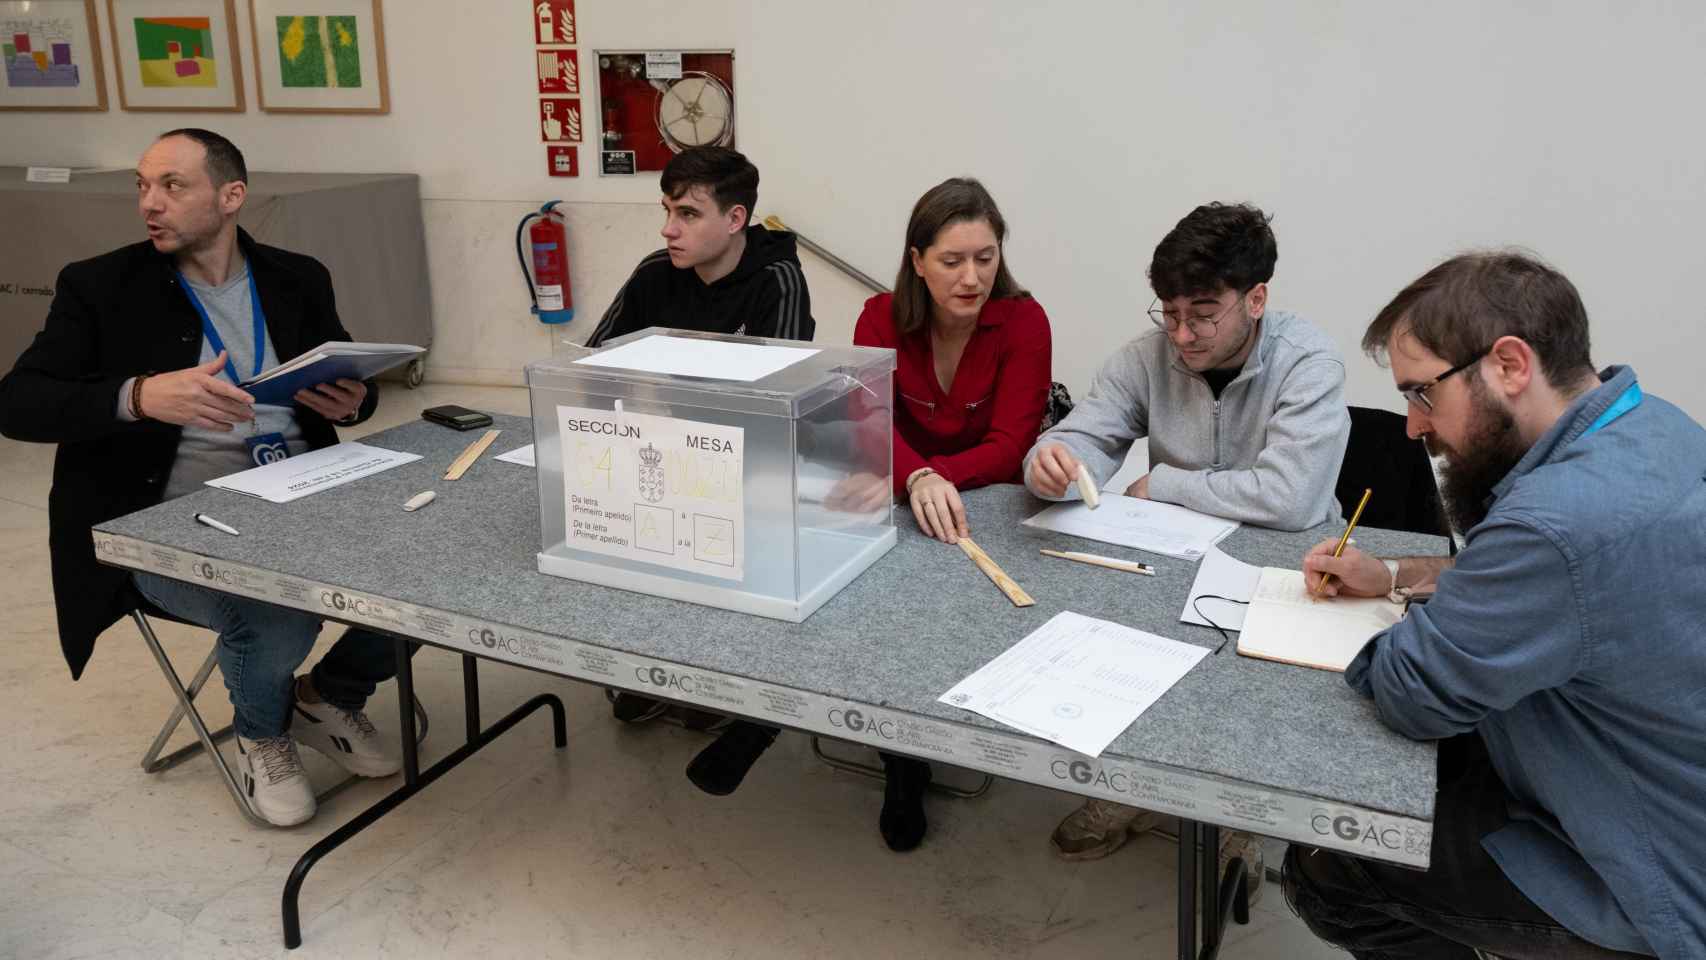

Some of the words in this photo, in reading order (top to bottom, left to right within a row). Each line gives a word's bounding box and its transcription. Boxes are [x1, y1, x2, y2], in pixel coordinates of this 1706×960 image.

[687, 435, 733, 453] MESA
[192, 562, 232, 585] CGAC
[321, 591, 369, 616] CGAC
[468, 629, 519, 655] CGAC
[635, 666, 693, 693] CGAC
[828, 709, 895, 740] CGAC
[1050, 760, 1128, 793] CGAC
[1311, 814, 1401, 850] CGAC
